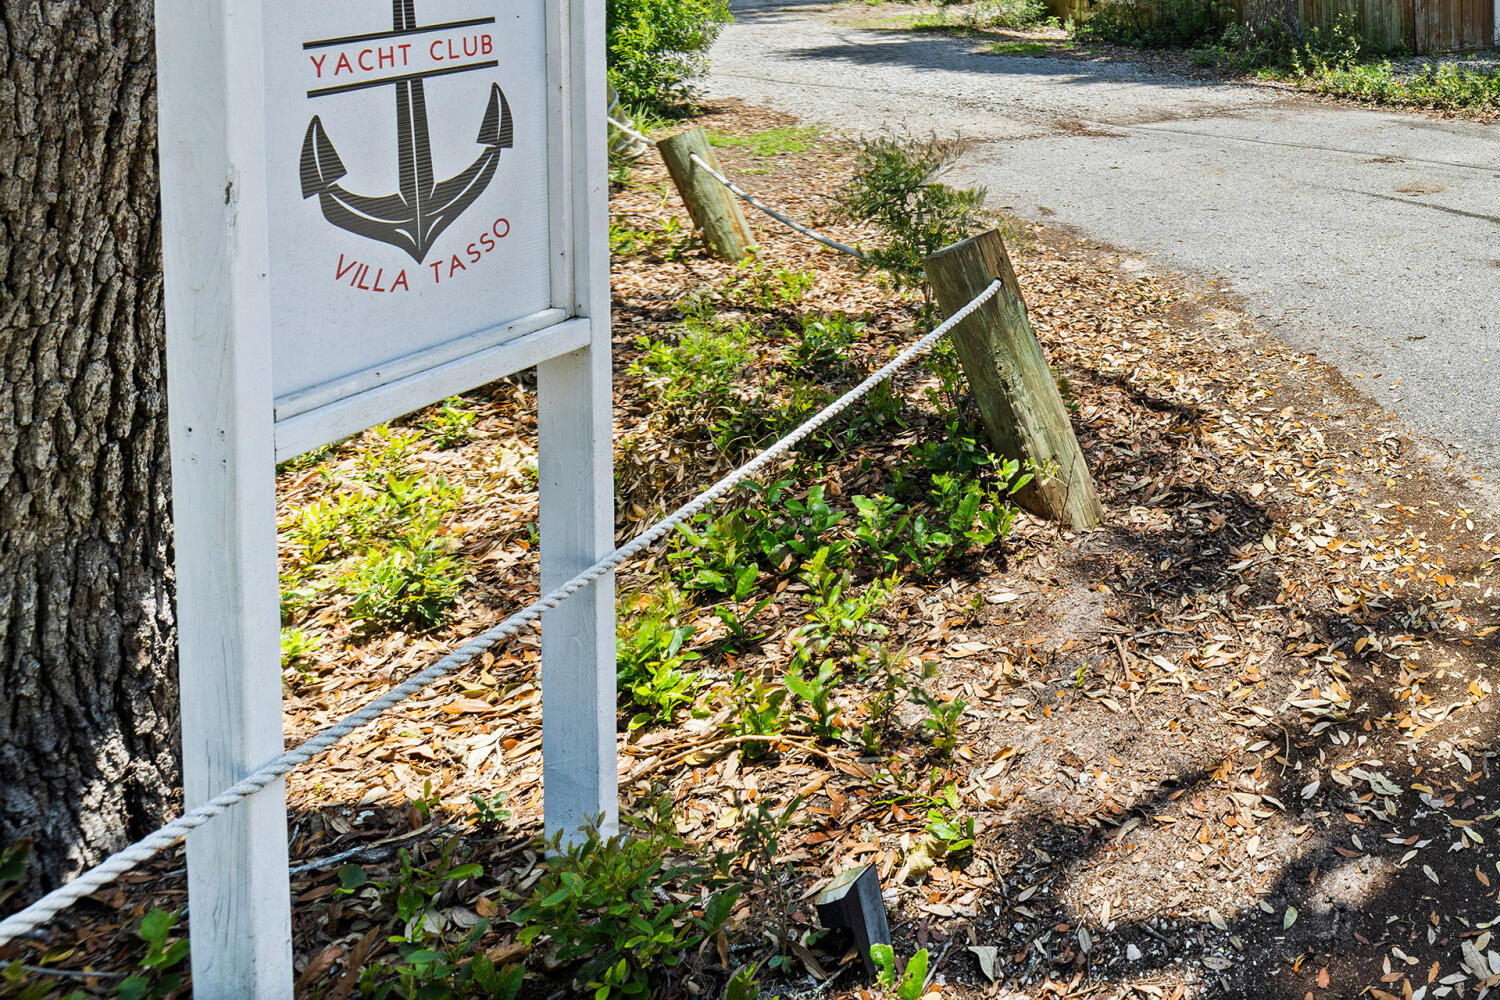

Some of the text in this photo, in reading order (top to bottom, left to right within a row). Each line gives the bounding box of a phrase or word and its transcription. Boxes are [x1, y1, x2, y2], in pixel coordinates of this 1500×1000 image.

[310, 34, 493, 78] YACHT CLUB
[336, 218, 510, 292] VILLA TASSO
